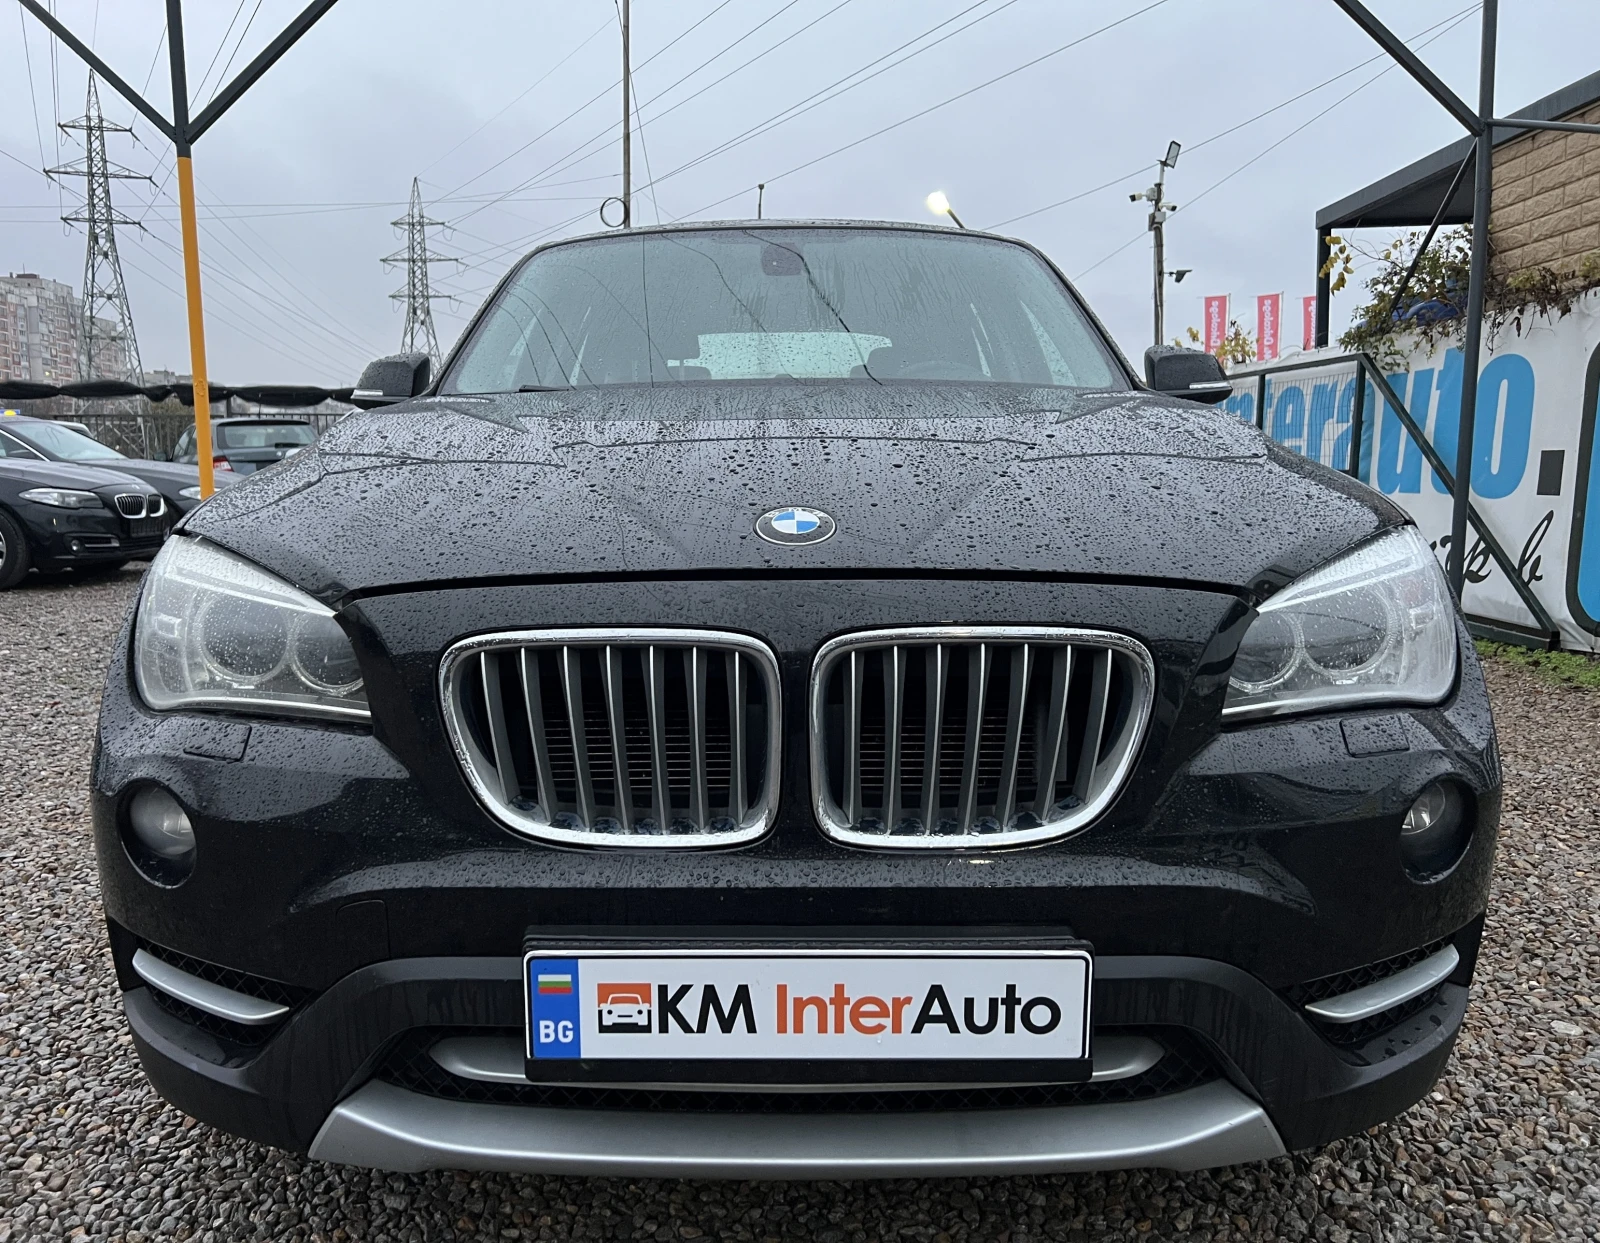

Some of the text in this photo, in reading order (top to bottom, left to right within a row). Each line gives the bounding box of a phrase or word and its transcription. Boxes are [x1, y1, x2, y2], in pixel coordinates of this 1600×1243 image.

[657, 983, 1062, 1035] KM InterAuto
[539, 1020, 574, 1043] BG
